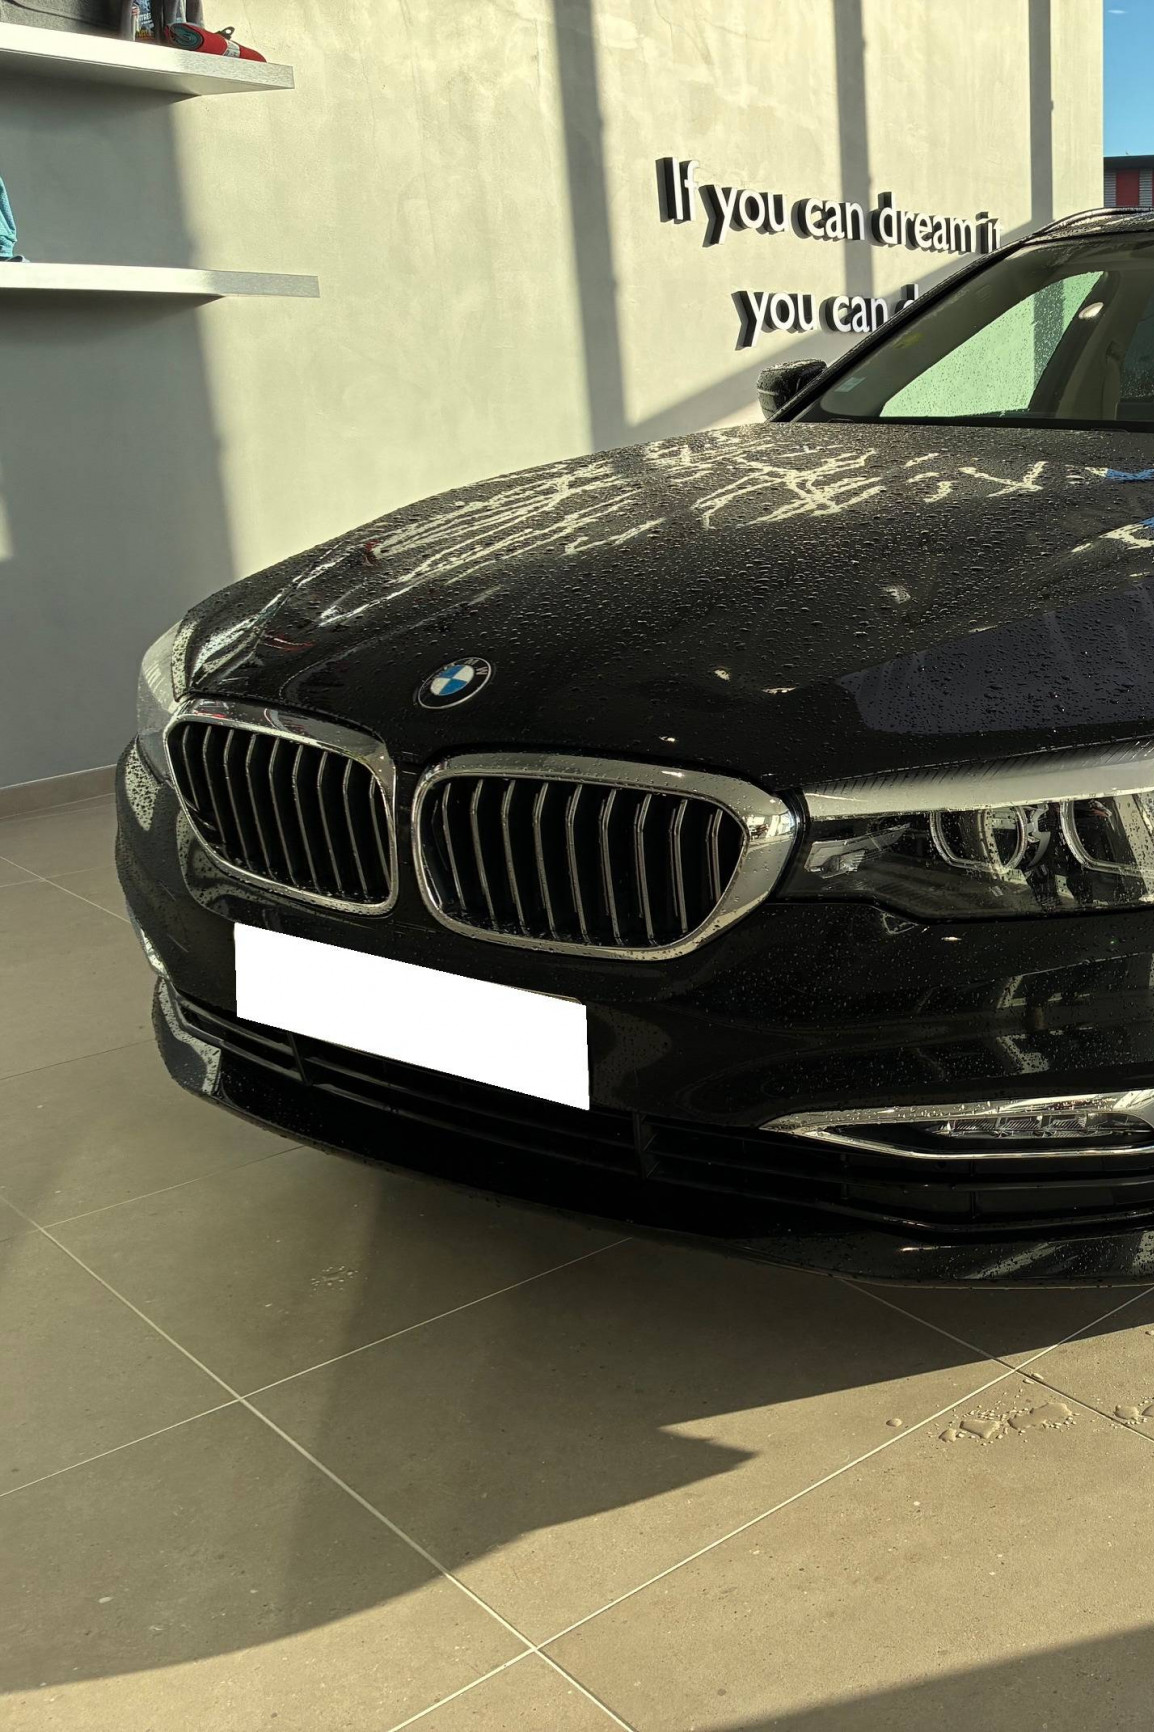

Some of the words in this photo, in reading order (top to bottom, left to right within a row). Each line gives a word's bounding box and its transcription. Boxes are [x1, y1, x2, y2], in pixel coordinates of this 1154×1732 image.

[656, 157, 700, 224] If
[698, 184, 789, 247] you
[791, 198, 865, 241] can
[868, 191, 976, 254] dream
[975, 211, 1004, 254] it
[731, 290, 815, 351] you
[819, 295, 889, 334] can
